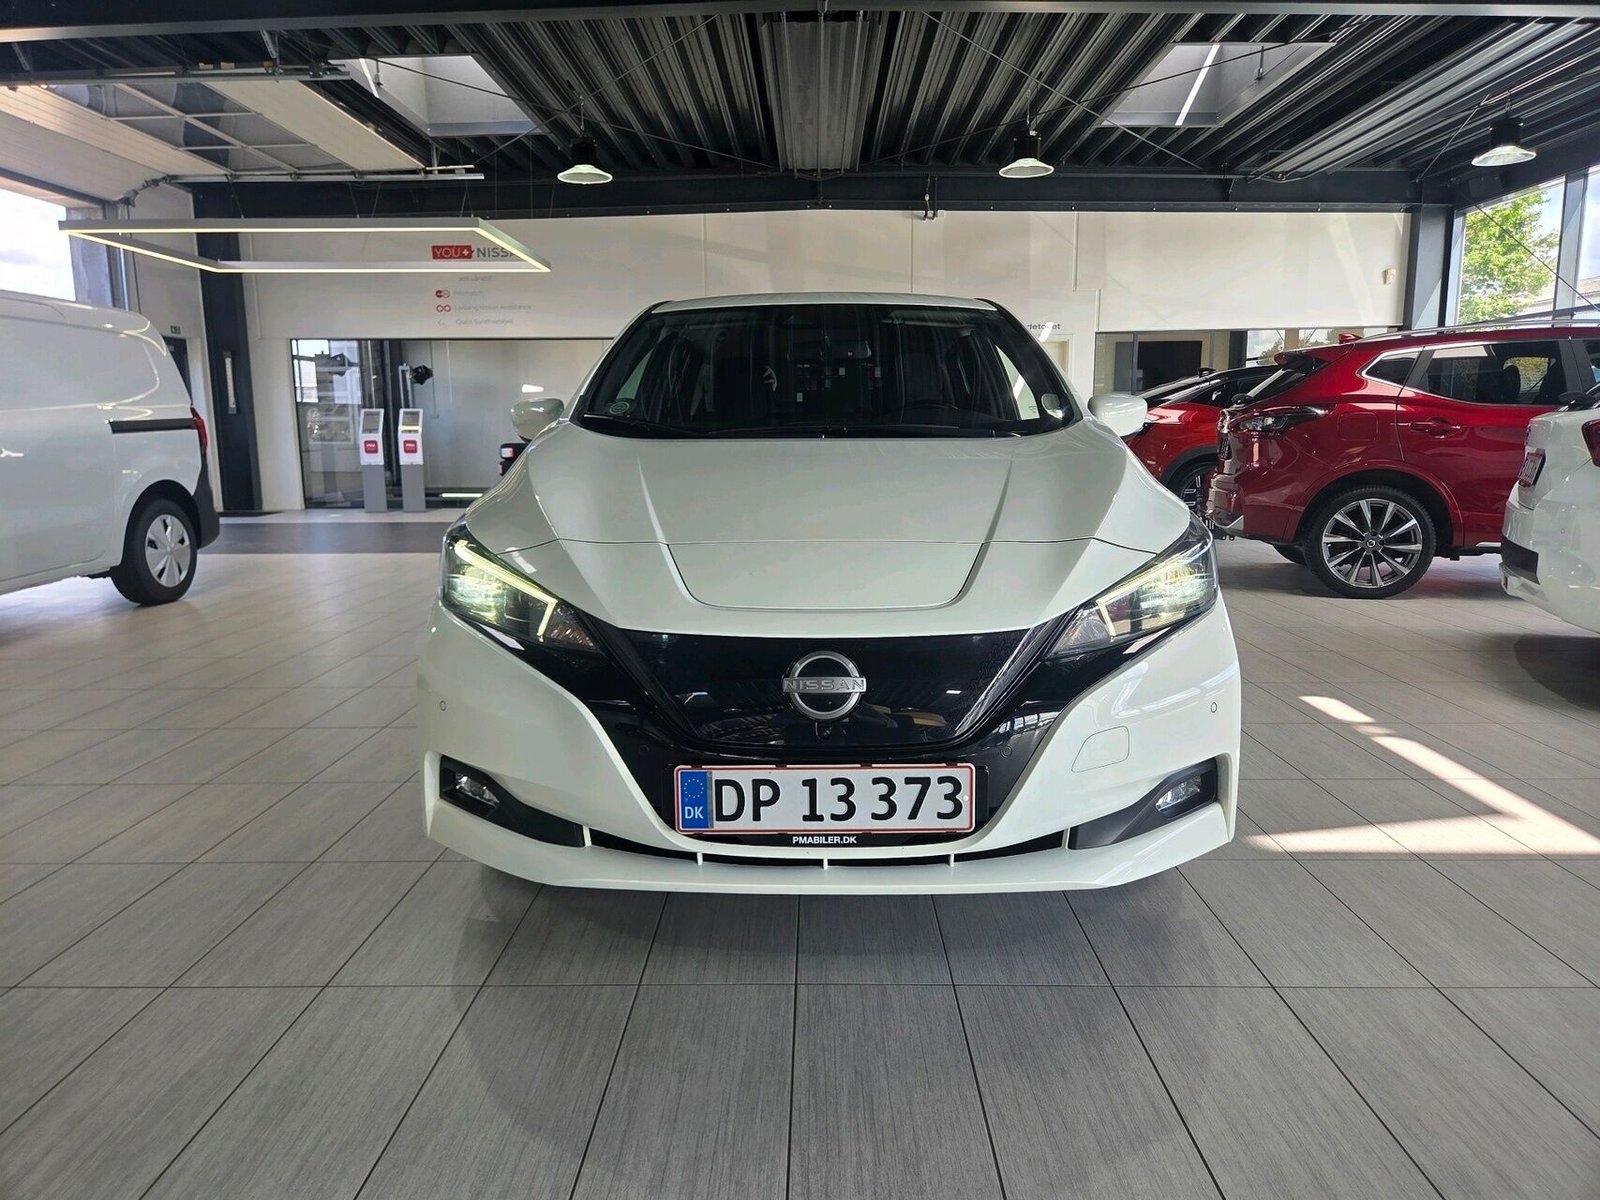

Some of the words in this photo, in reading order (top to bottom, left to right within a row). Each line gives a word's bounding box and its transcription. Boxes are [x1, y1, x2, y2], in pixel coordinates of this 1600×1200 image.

[784, 679, 865, 691] NISSAN
[714, 778, 780, 822] DP
[802, 777, 857, 822] 13
[871, 775, 963, 821] 373
[684, 806, 704, 819] DK
[792, 836, 857, 844] PMABILER.DK
